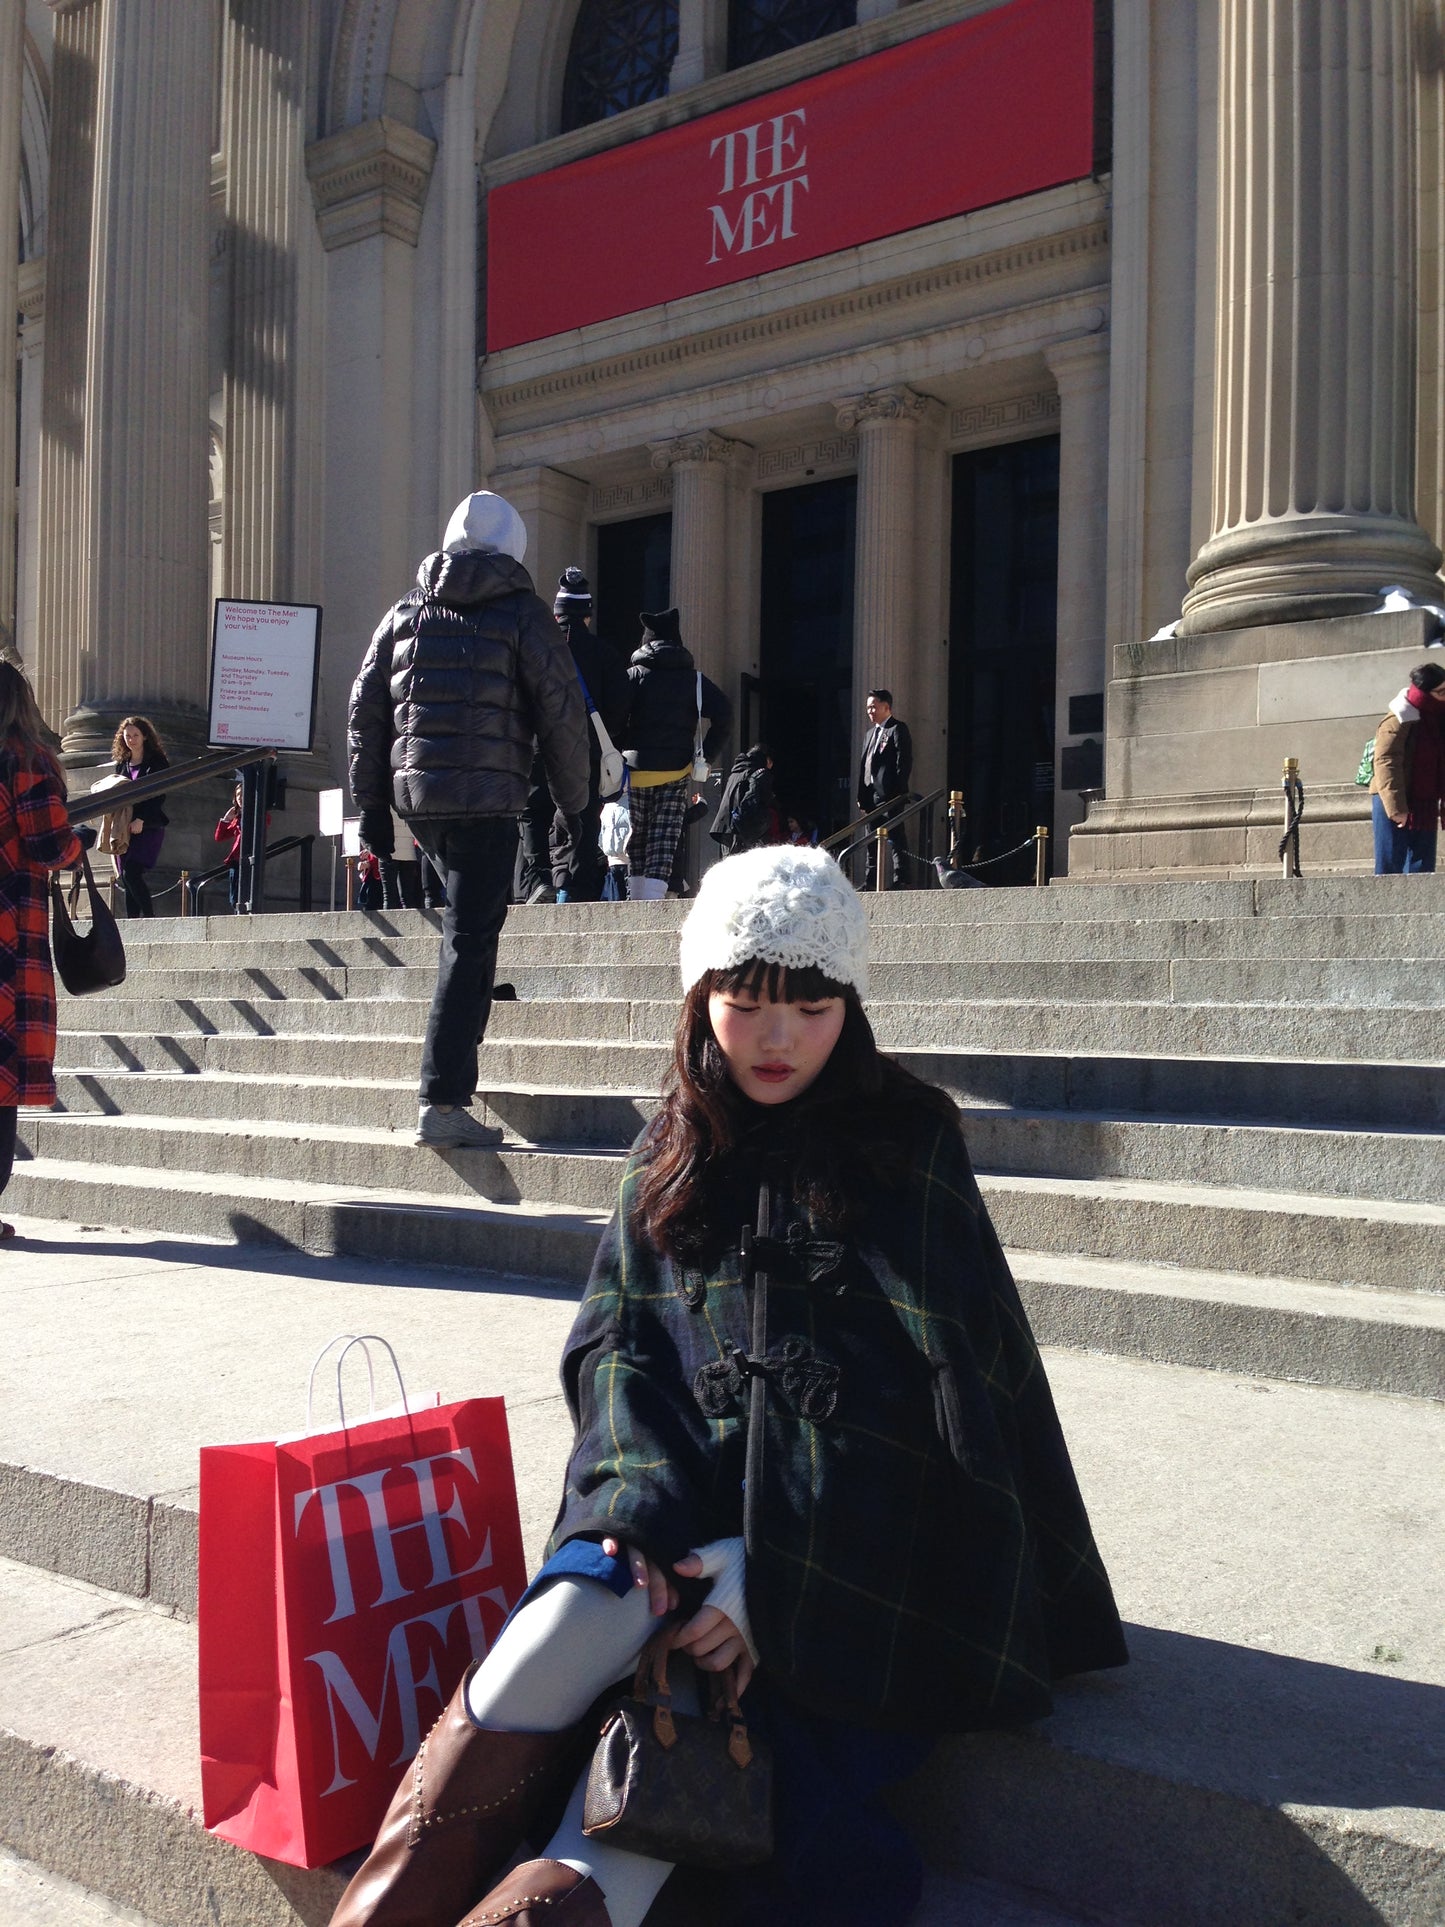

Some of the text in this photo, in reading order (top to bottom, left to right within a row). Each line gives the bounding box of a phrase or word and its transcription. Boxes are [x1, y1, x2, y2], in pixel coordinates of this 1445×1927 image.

[709, 108, 807, 195] THE
[705, 174, 809, 264] MET
[225, 606, 258, 614] Welcome
[237, 615, 255, 623] hope
[270, 617, 290, 626] enjoy
[294, 1446, 493, 1625] THE
[304, 1585, 510, 1798] MET
